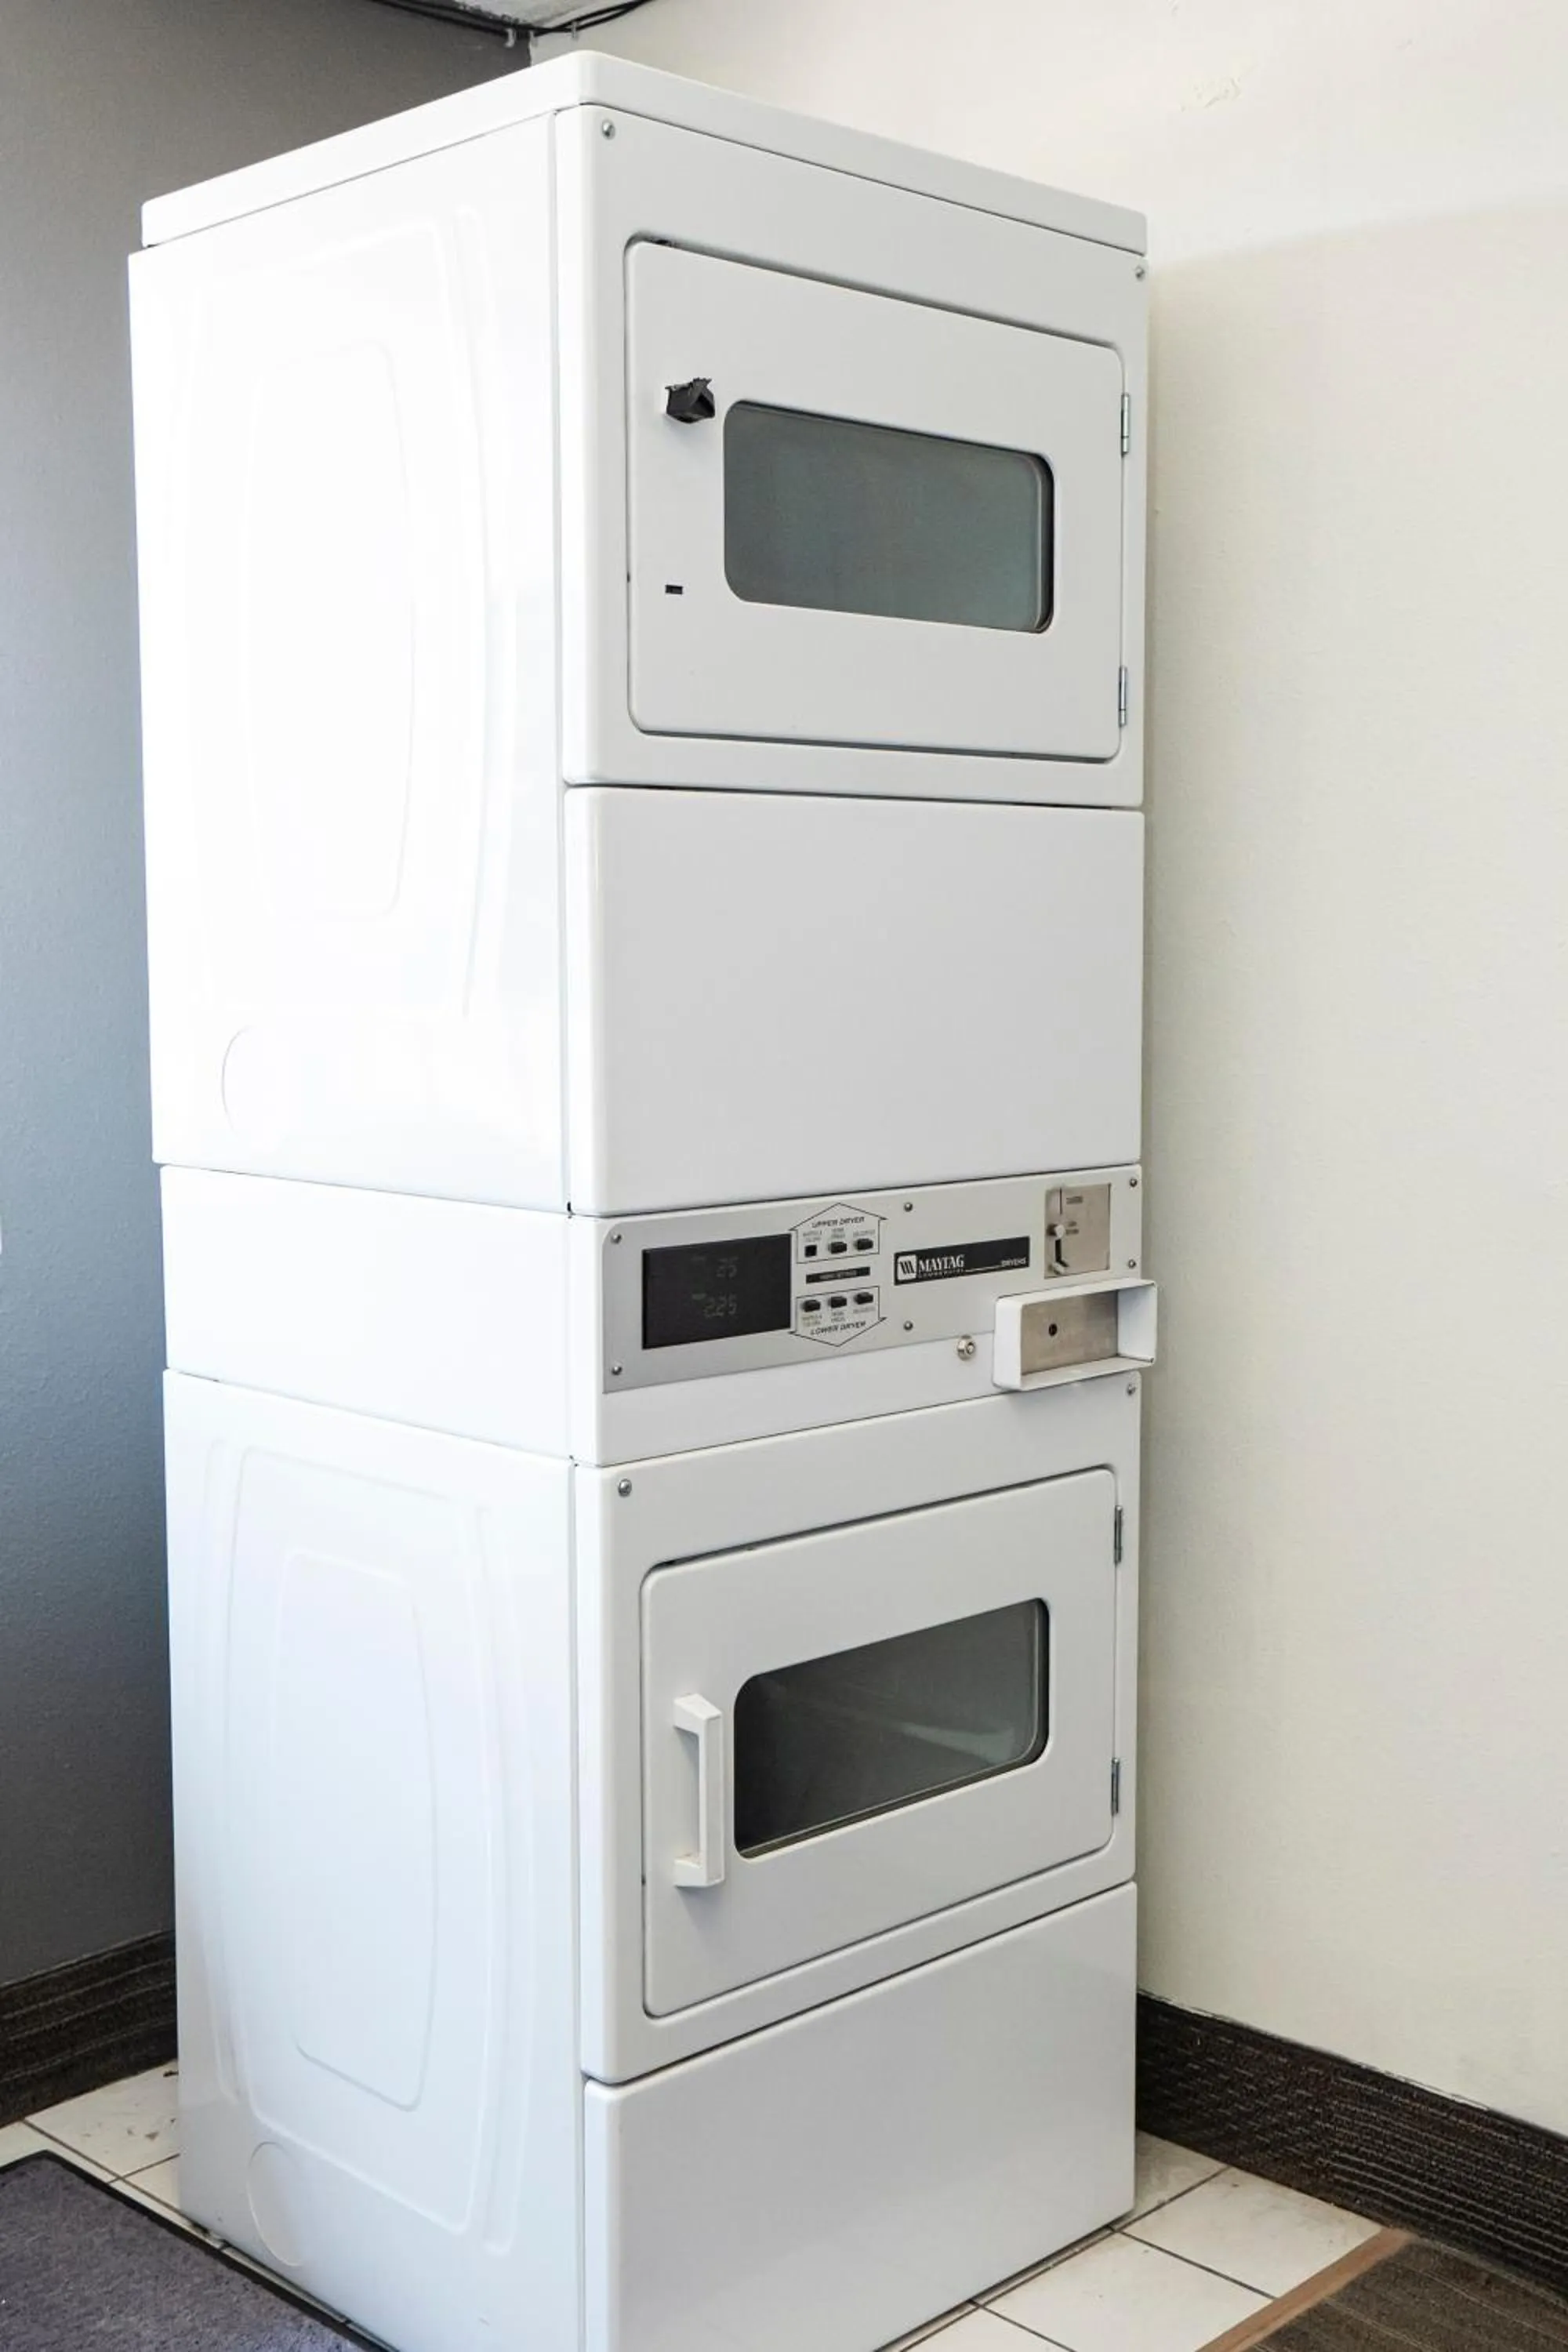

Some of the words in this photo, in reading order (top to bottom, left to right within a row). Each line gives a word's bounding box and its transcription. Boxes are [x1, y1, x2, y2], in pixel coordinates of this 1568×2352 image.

[811, 1220, 838, 1229] UPPER
[840, 1217, 865, 1225] DRYER
[918, 1254, 965, 1272] MAYTAG
[1000, 1256, 1027, 1267] DRYERS
[810, 1325, 839, 1335] LOWER
[840, 1320, 866, 1330] DRYER
